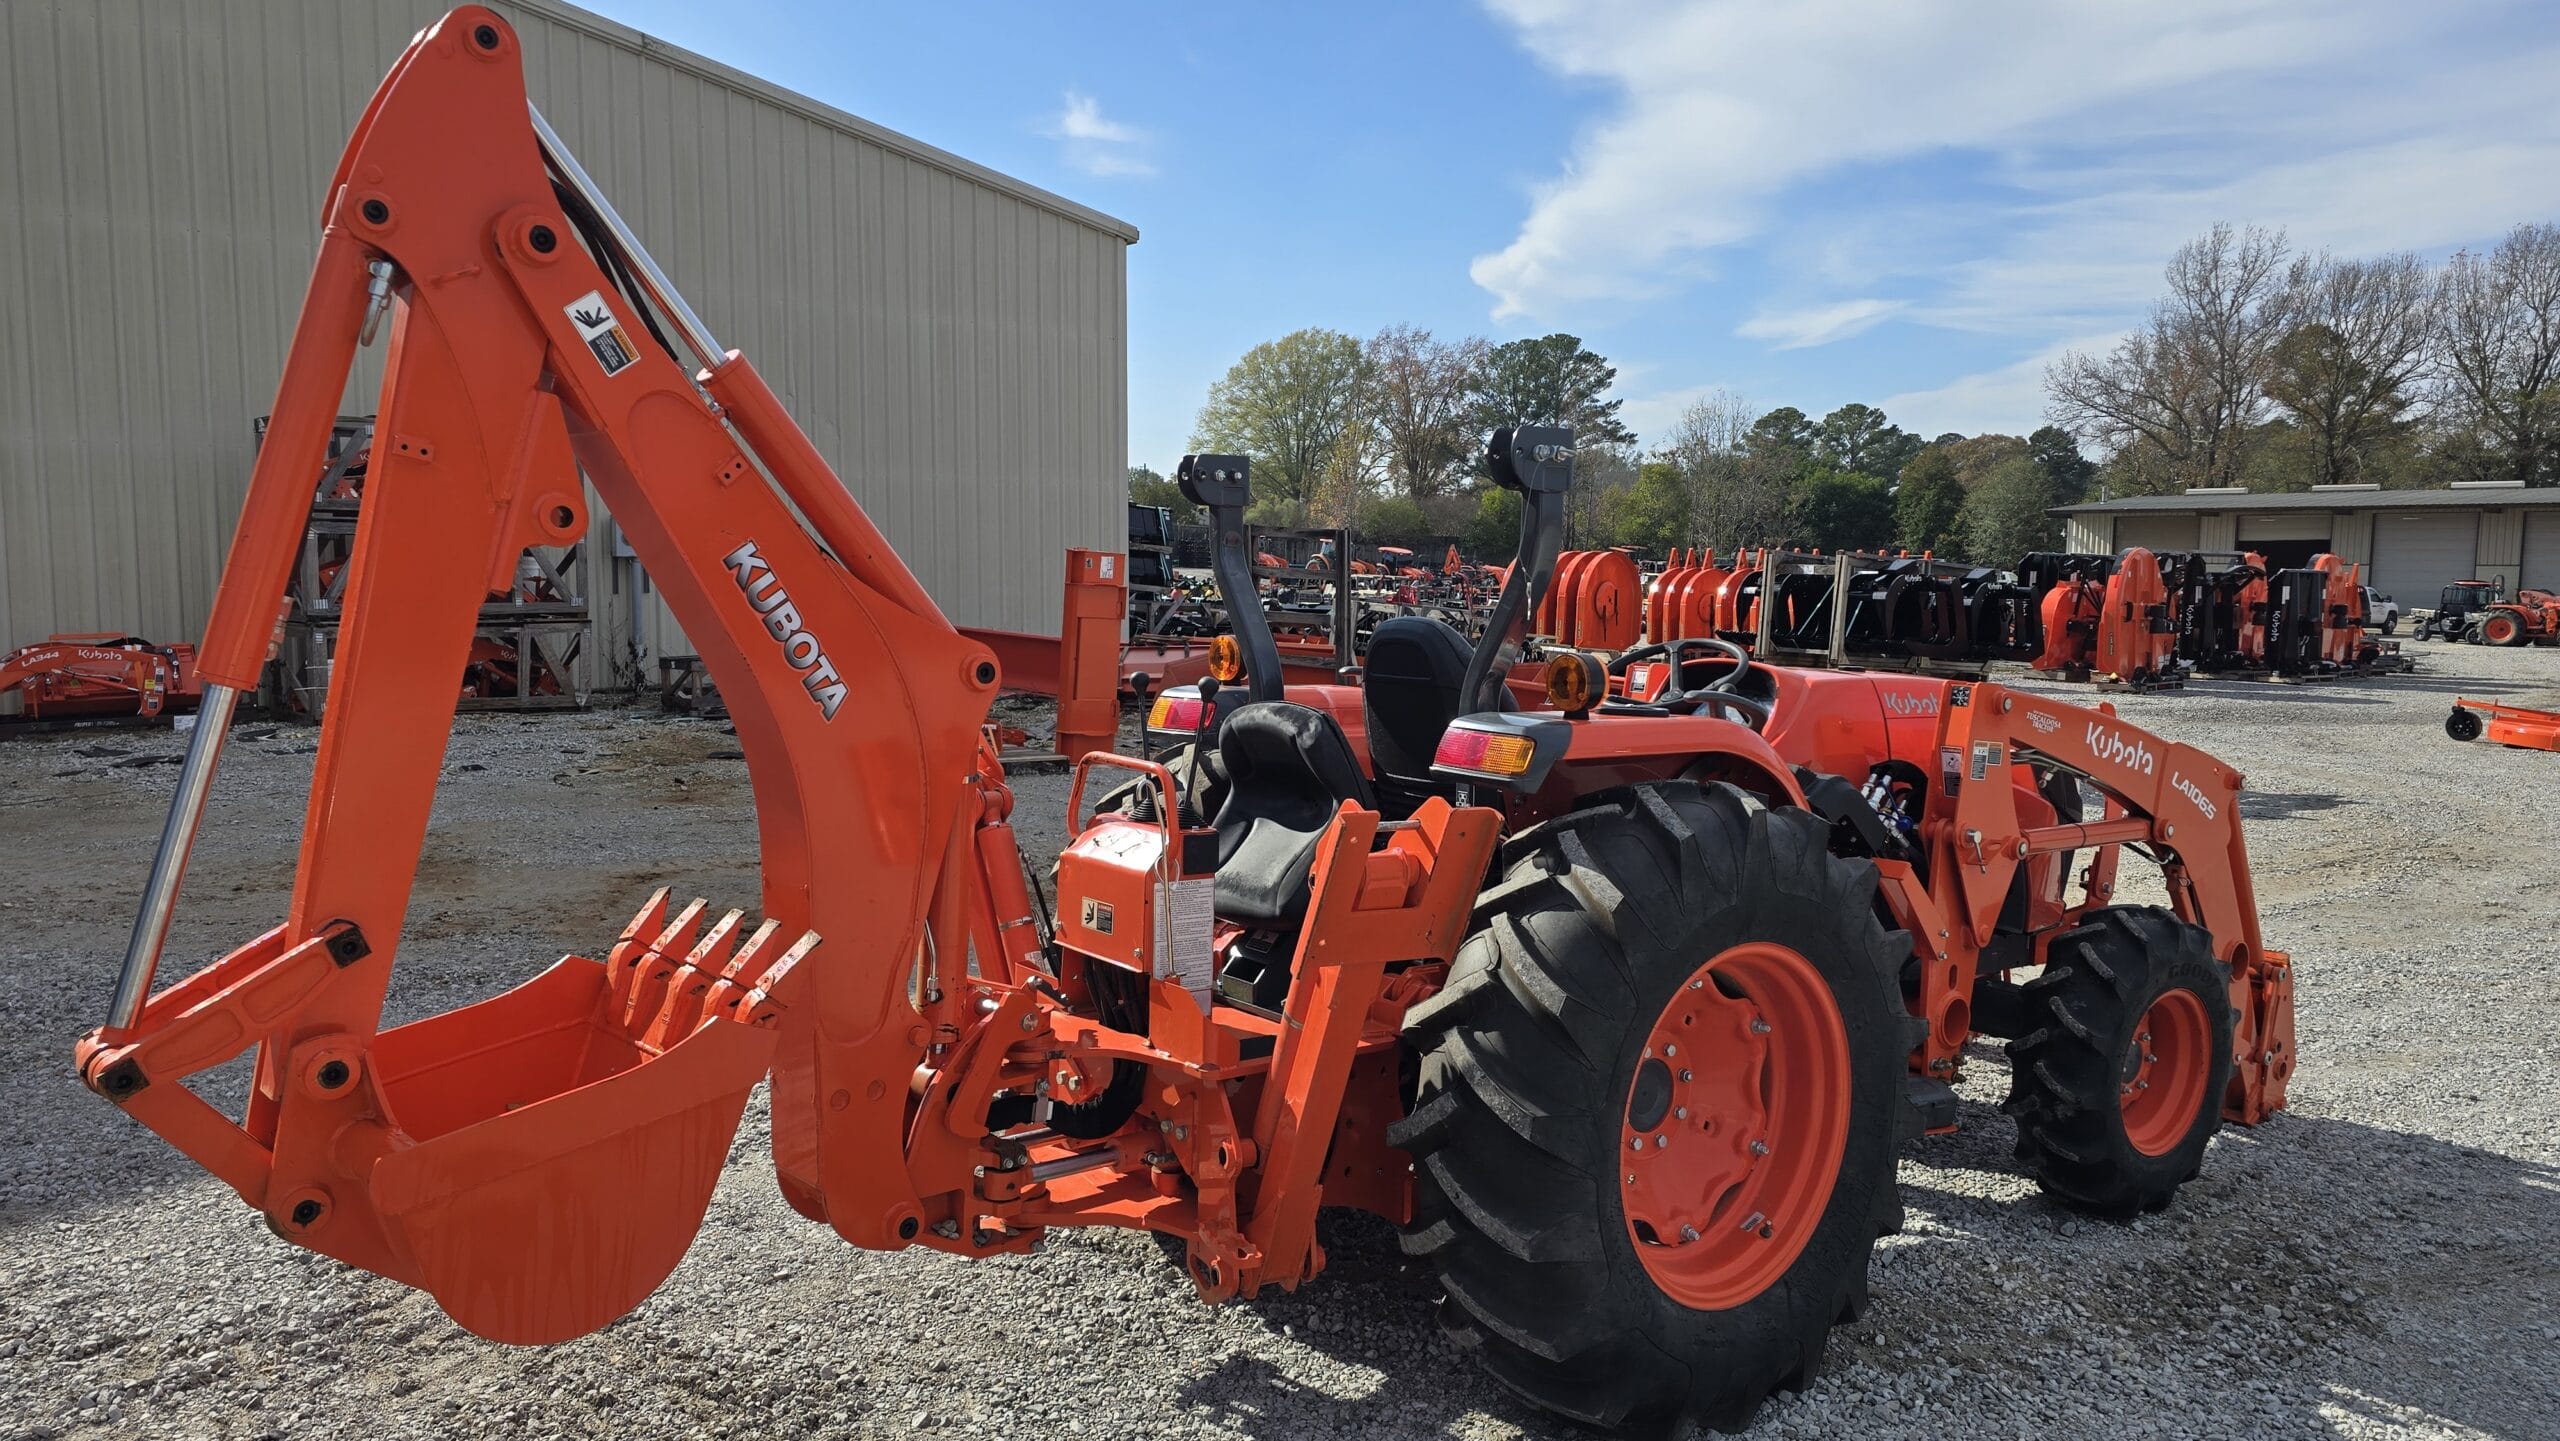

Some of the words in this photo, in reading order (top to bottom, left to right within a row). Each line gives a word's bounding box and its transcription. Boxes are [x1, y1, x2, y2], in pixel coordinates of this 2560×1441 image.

[722, 540, 849, 722] KUBOTA
[2185, 604, 2194, 635] Kubota
[2271, 610, 2281, 642] Kubota
[21, 650, 60, 668] LA344
[78, 649, 122, 661] Kubota
[1884, 692, 1939, 714] Kubot
[2085, 721, 2153, 776] Kubota
[2171, 771, 2217, 820] LA1065
